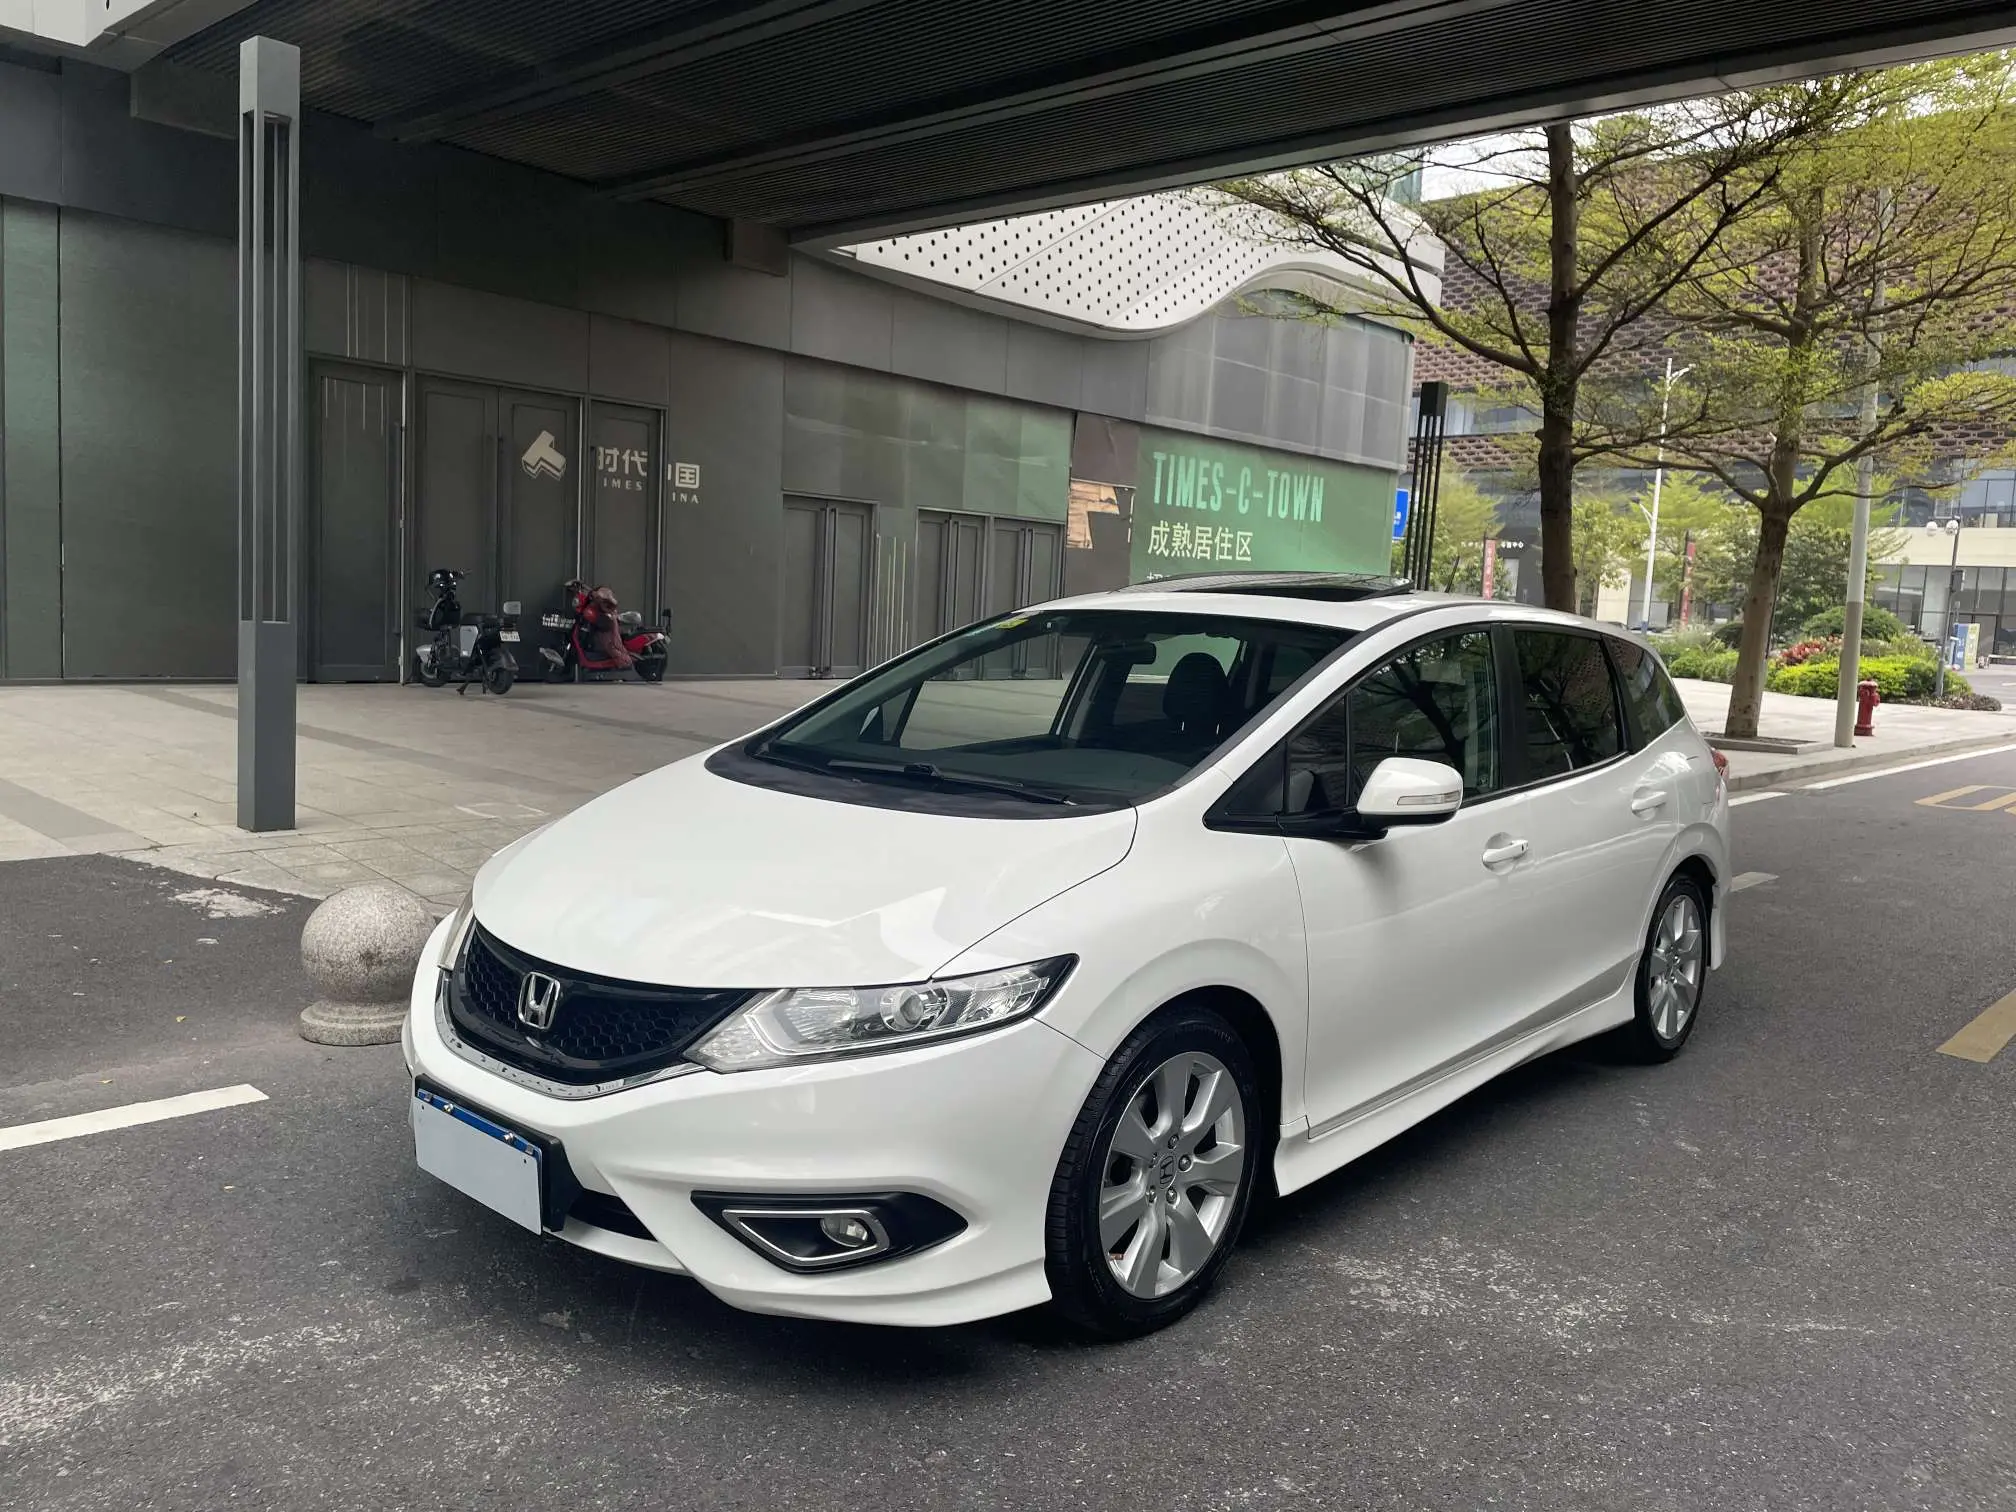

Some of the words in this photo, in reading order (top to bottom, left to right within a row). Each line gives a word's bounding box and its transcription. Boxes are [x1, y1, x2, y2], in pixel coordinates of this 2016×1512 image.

[603, 477, 643, 491] IMES
[667, 462, 700, 489] 国
[1153, 451, 1325, 523] TIMES-C-TOWN
[1148, 520, 1254, 562] 成熟居住区
